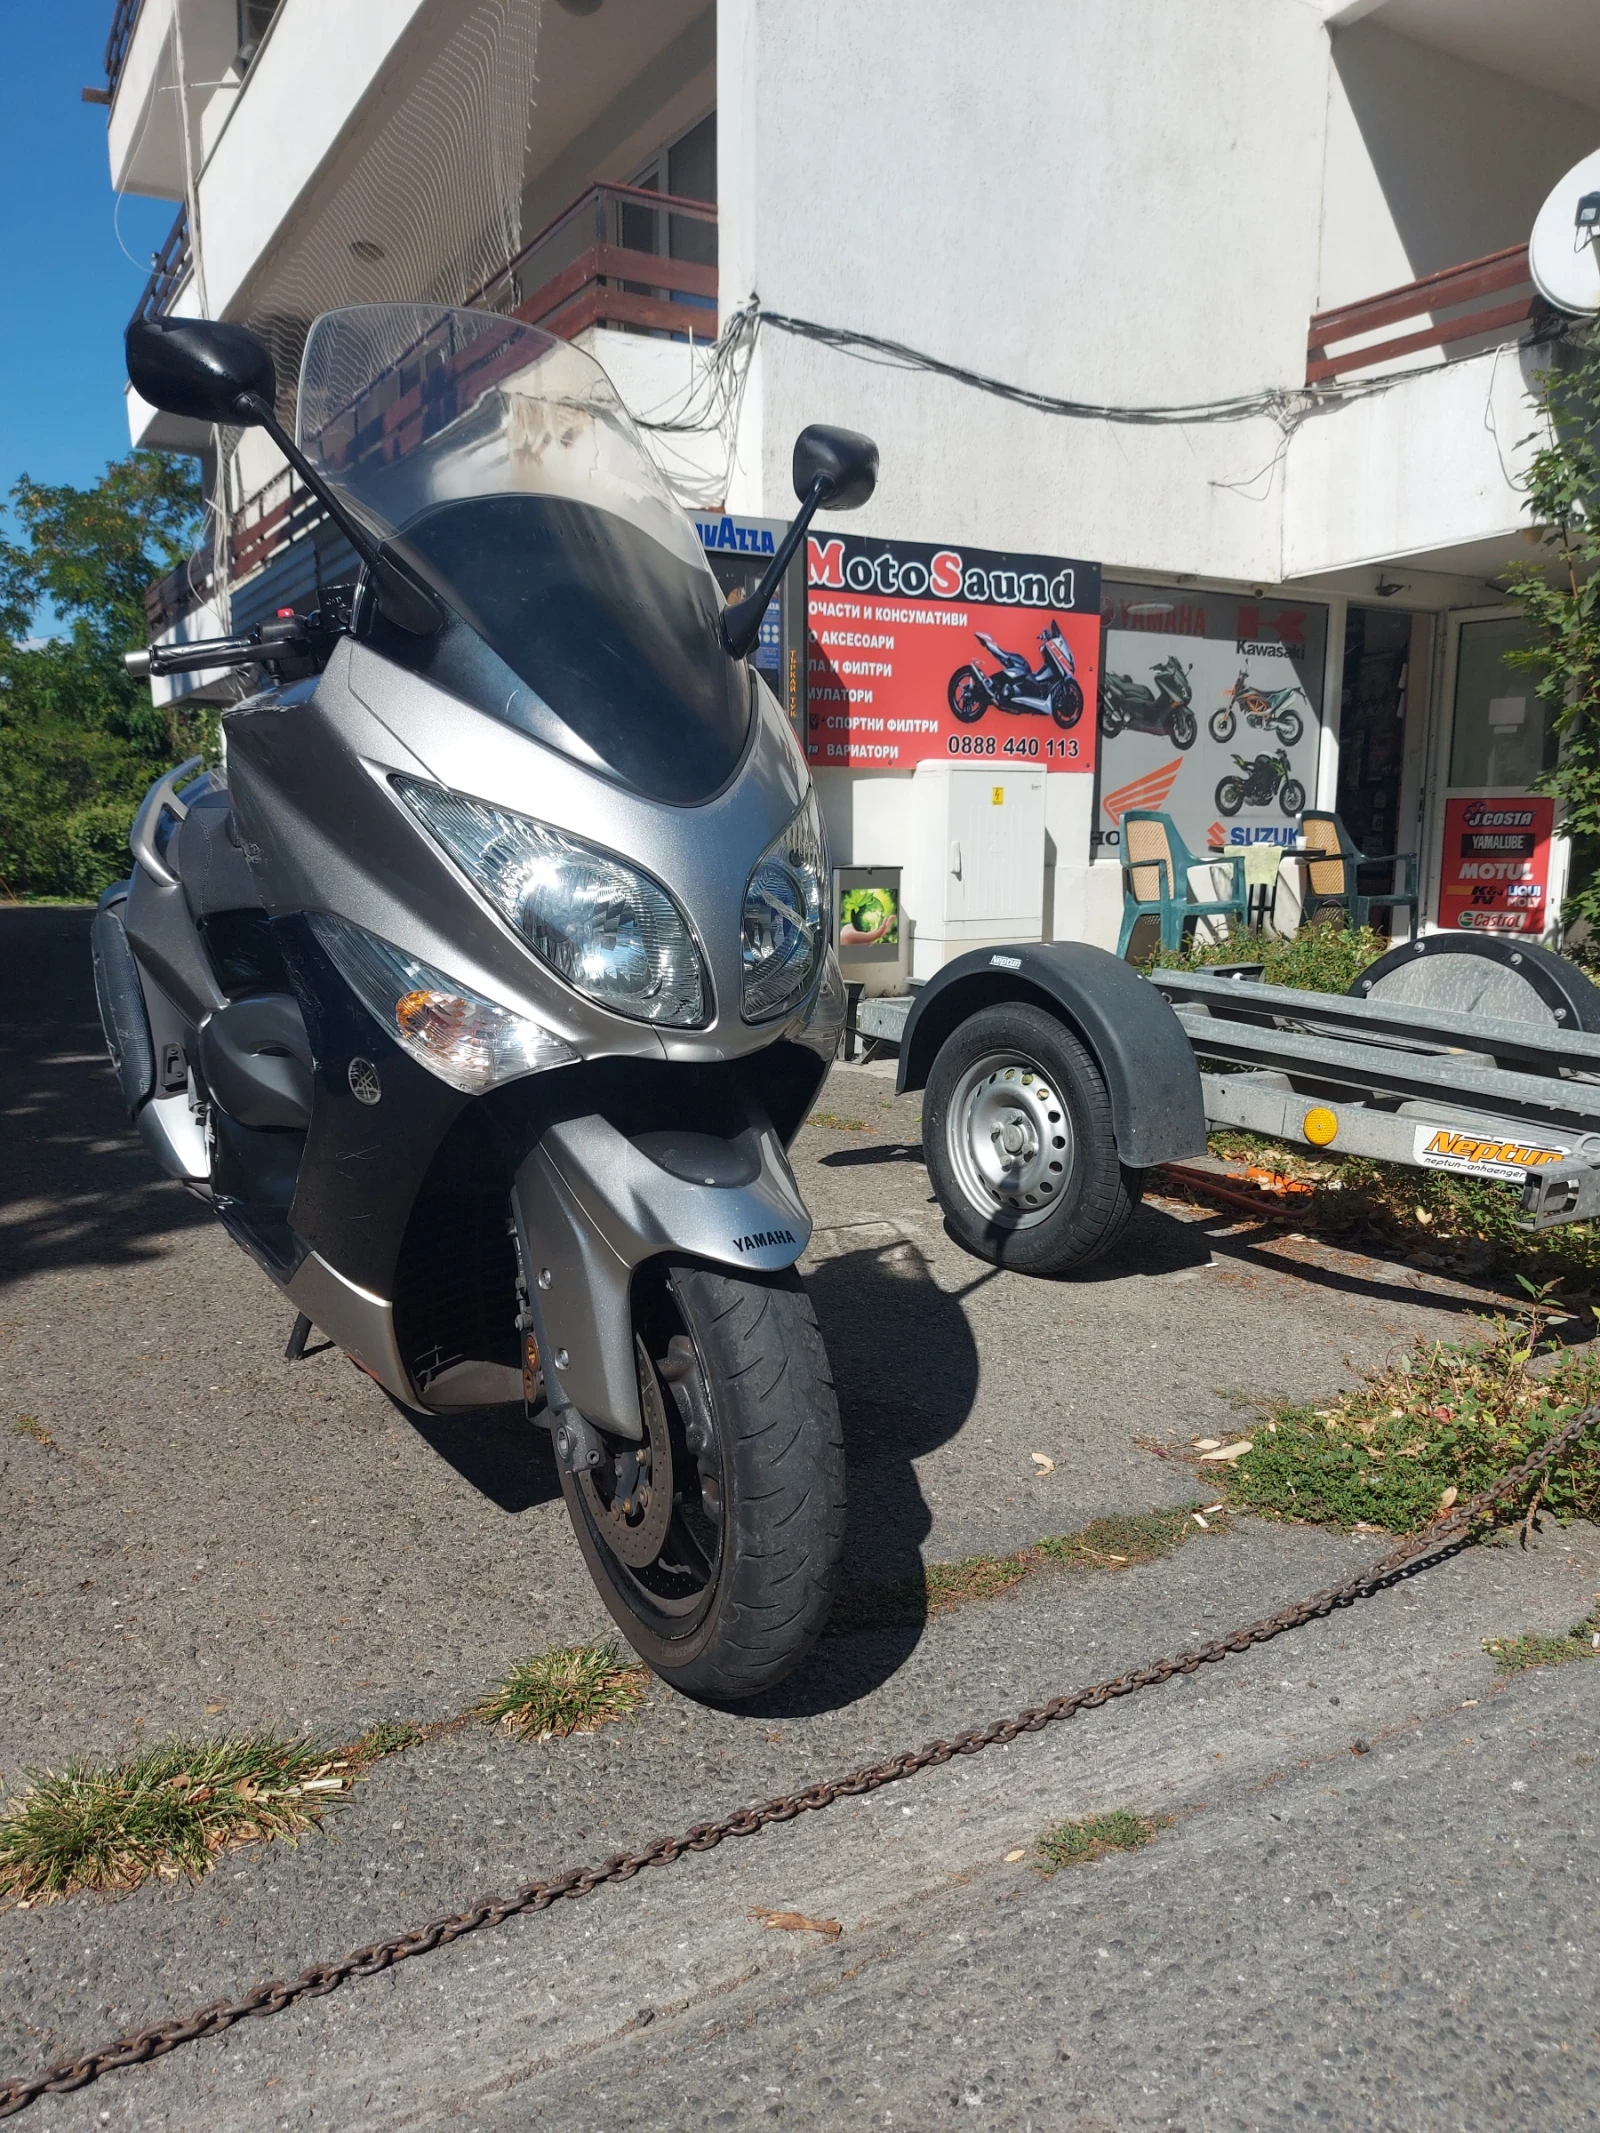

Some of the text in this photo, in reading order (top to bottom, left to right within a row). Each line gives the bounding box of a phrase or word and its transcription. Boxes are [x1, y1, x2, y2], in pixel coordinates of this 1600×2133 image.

[808, 537, 1075, 608] MotoSaund
[808, 601, 968, 627] ОЧАСТИ И КОНСУМАТИВИ
[1119, 599, 1205, 637] YAMAHA
[821, 630, 894, 649] АКСЕСОАРИ
[1236, 640, 1305, 660] Kawasaki
[830, 659, 839, 672] И
[842, 660, 892, 677] ФИЛТРИ
[808, 687, 873, 703] МУЛАТОРИ
[826, 715, 939, 733] СПОРТНИ ФИЛТРИ
[826, 743, 899, 758] ВАРИАТОРИ
[948, 734, 1080, 758] 0888 440 113
[1468, 811, 1534, 827] J.COSTA
[1230, 826, 1299, 846] SUZUK
[1472, 835, 1525, 850] YAMALUBE
[1458, 862, 1535, 881] MOTUL
[1507, 885, 1542, 896] LIQUI
[1506, 897, 1541, 908] MOLY
[1473, 912, 1522, 928] Castrol
[990, 954, 1021, 968] Neptun
[1425, 1131, 1565, 1166] Neptun
[732, 1230, 797, 1252] YAMAHA
